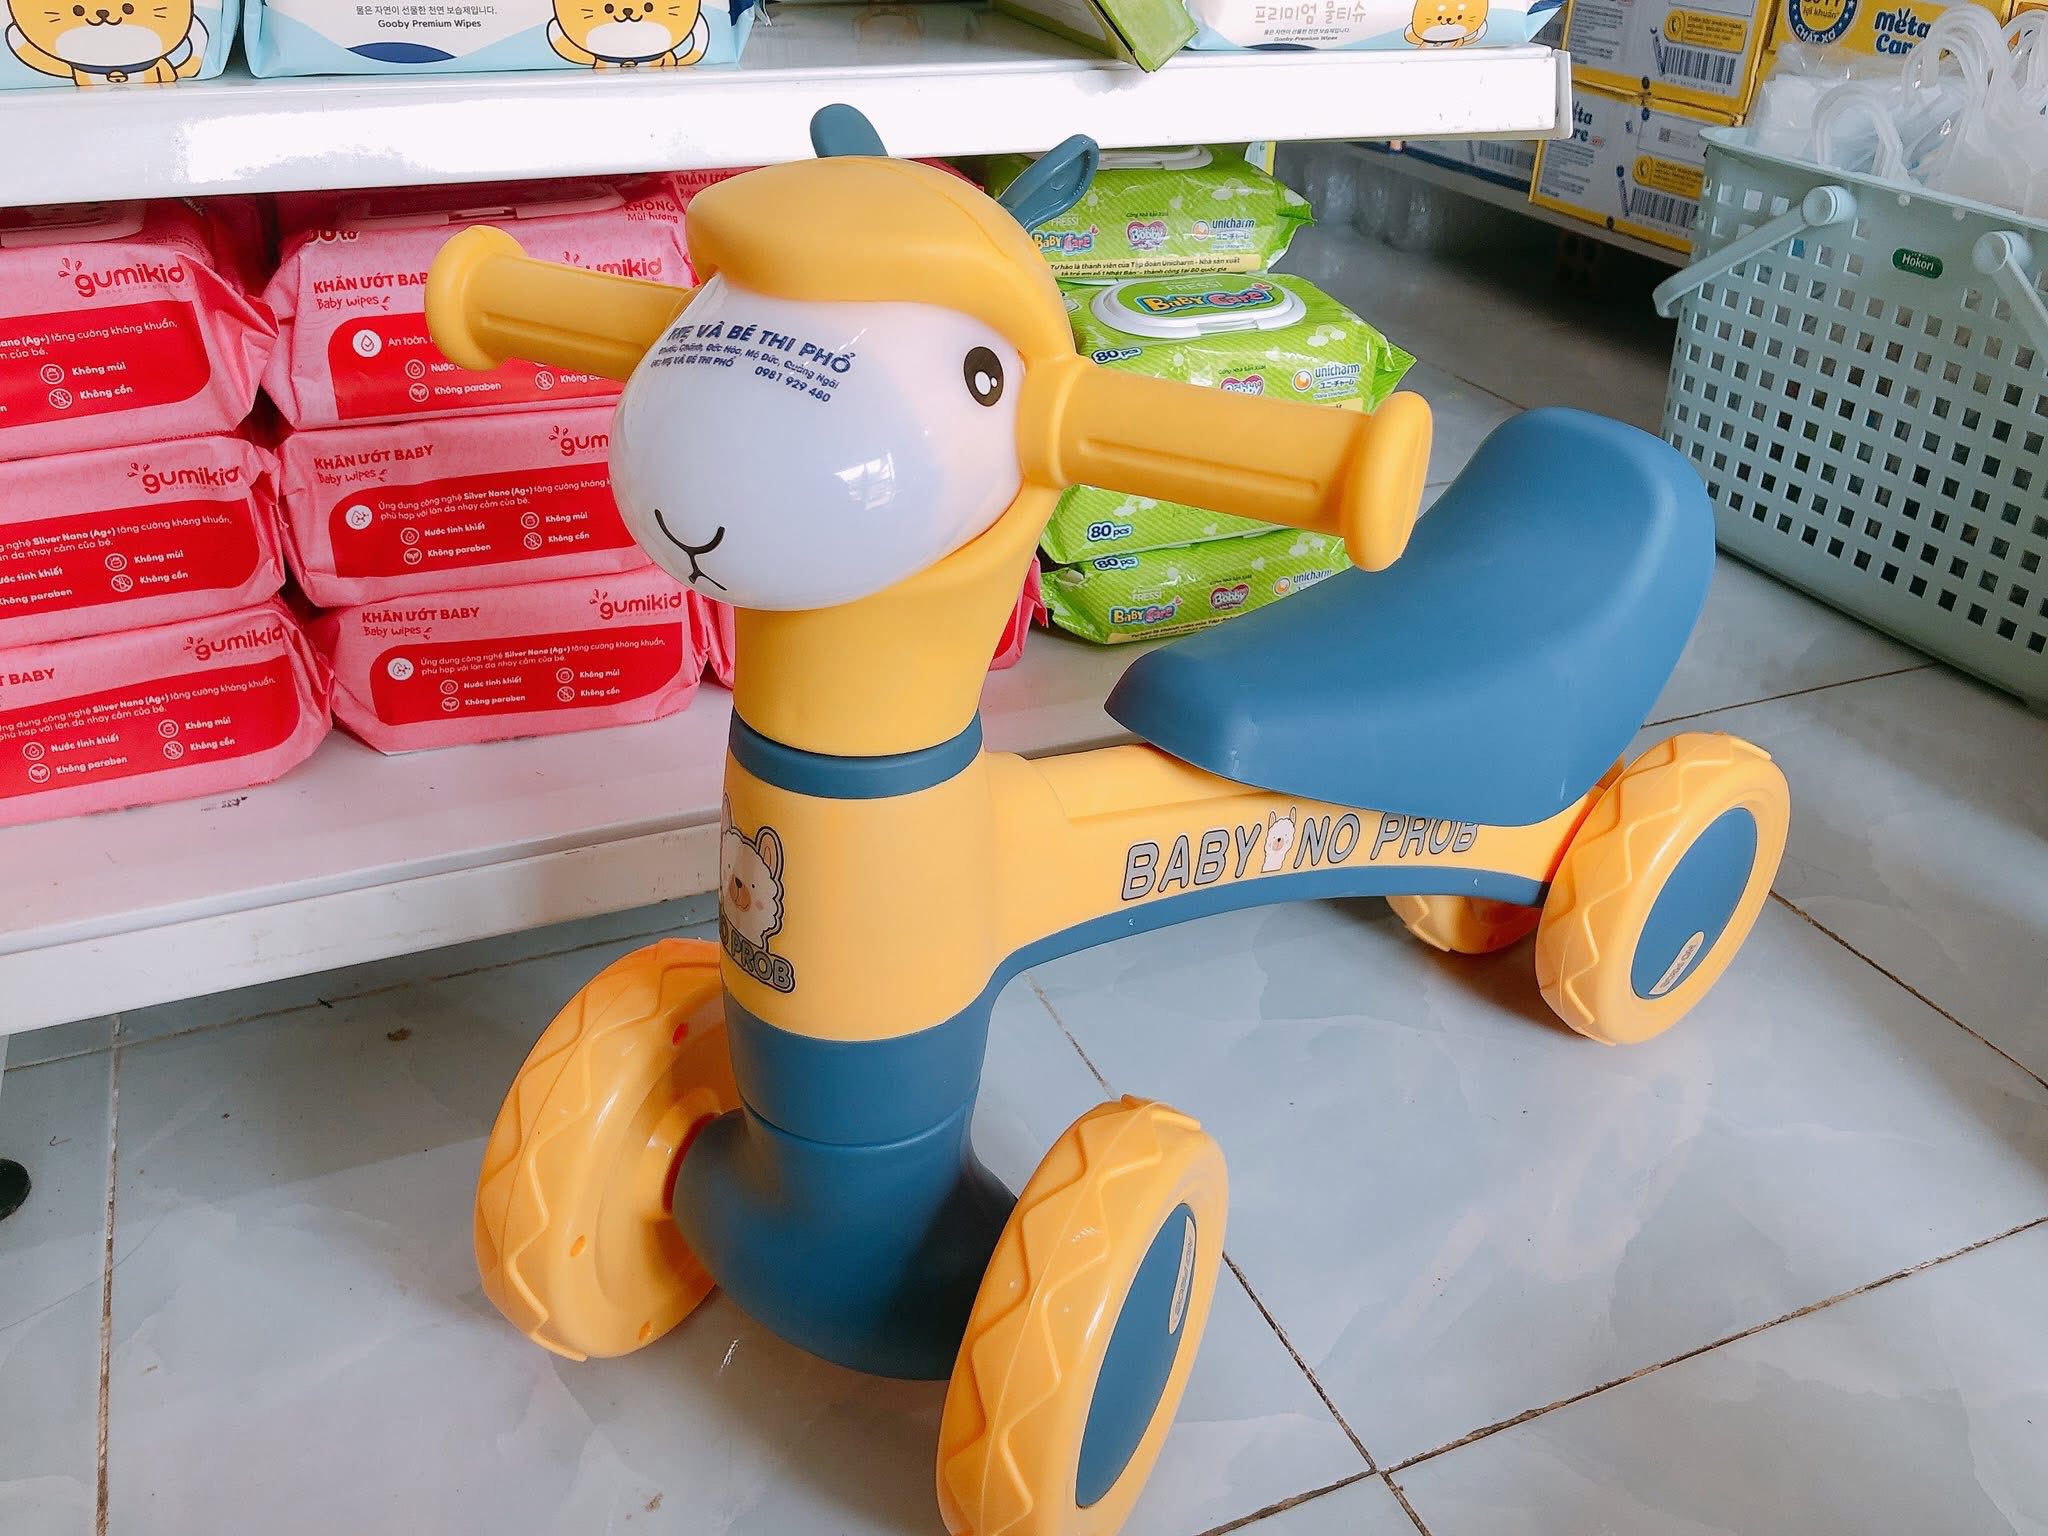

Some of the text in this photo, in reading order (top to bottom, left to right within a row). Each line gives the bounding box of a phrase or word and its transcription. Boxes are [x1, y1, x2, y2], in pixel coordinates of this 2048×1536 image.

[374, 5, 400, 16] 자연이
[1255, 3, 1317, 25] 프리미엄
[378, 19, 482, 30] Gooby Premium Wipes
[1876, 33, 1913, 55] Car
[1212, 217, 1255, 230] unicharm
[1130, 225, 1163, 241] Bobby
[1063, 234, 1091, 252] Care
[1902, 253, 1934, 272] Hokori
[75, 263, 185, 298] gumikid
[313, 271, 429, 294] KHĂN ƯỚT BAB
[317, 295, 379, 310] Baby wipes
[1207, 290, 1265, 306] Care
[388, 337, 402, 348] An
[697, 321, 725, 338] VÀ
[726, 324, 757, 341] BÉ
[758, 330, 796, 351] THI
[799, 343, 856, 373] PHỔ
[1095, 348, 1141, 362] 80 pcs
[72, 365, 105, 377] Không
[1315, 364, 1360, 377] unicharm
[434, 382, 502, 397] Không paraben
[755, 366, 831, 402] 0981 929 480
[79, 389, 113, 400] Không
[313, 444, 434, 471] KHĂN ƯỚT BABY
[142, 466, 239, 494] gumikid
[317, 469, 377, 486] Baby wipes
[464, 491, 487, 500] Silver
[488, 489, 510, 498] Nano
[545, 515, 571, 523] Không
[32, 535, 61, 546] Silver
[62, 532, 88, 542] Nano
[1089, 525, 1130, 539] 80 pcs
[427, 544, 491, 558] Không paraben
[134, 554, 164, 564] Không
[1097, 557, 1136, 570] 80 pcs
[140, 574, 170, 584] Không
[1292, 569, 1333, 584] unicharm
[30, 589, 73, 603] paraben
[1213, 591, 1247, 604] Bobby
[599, 591, 682, 620] gumikid
[362, 605, 480, 624] KHĂN ƯỚT BABY
[1146, 606, 1173, 623] Care
[363, 625, 422, 638] Baby wipes
[9, 668, 55, 685] BABY
[492, 695, 526, 705] paraben
[87, 756, 128, 771] paraben
[1122, 811, 1479, 901] BABY NO PROB
[731, 930, 791, 989] PROB
